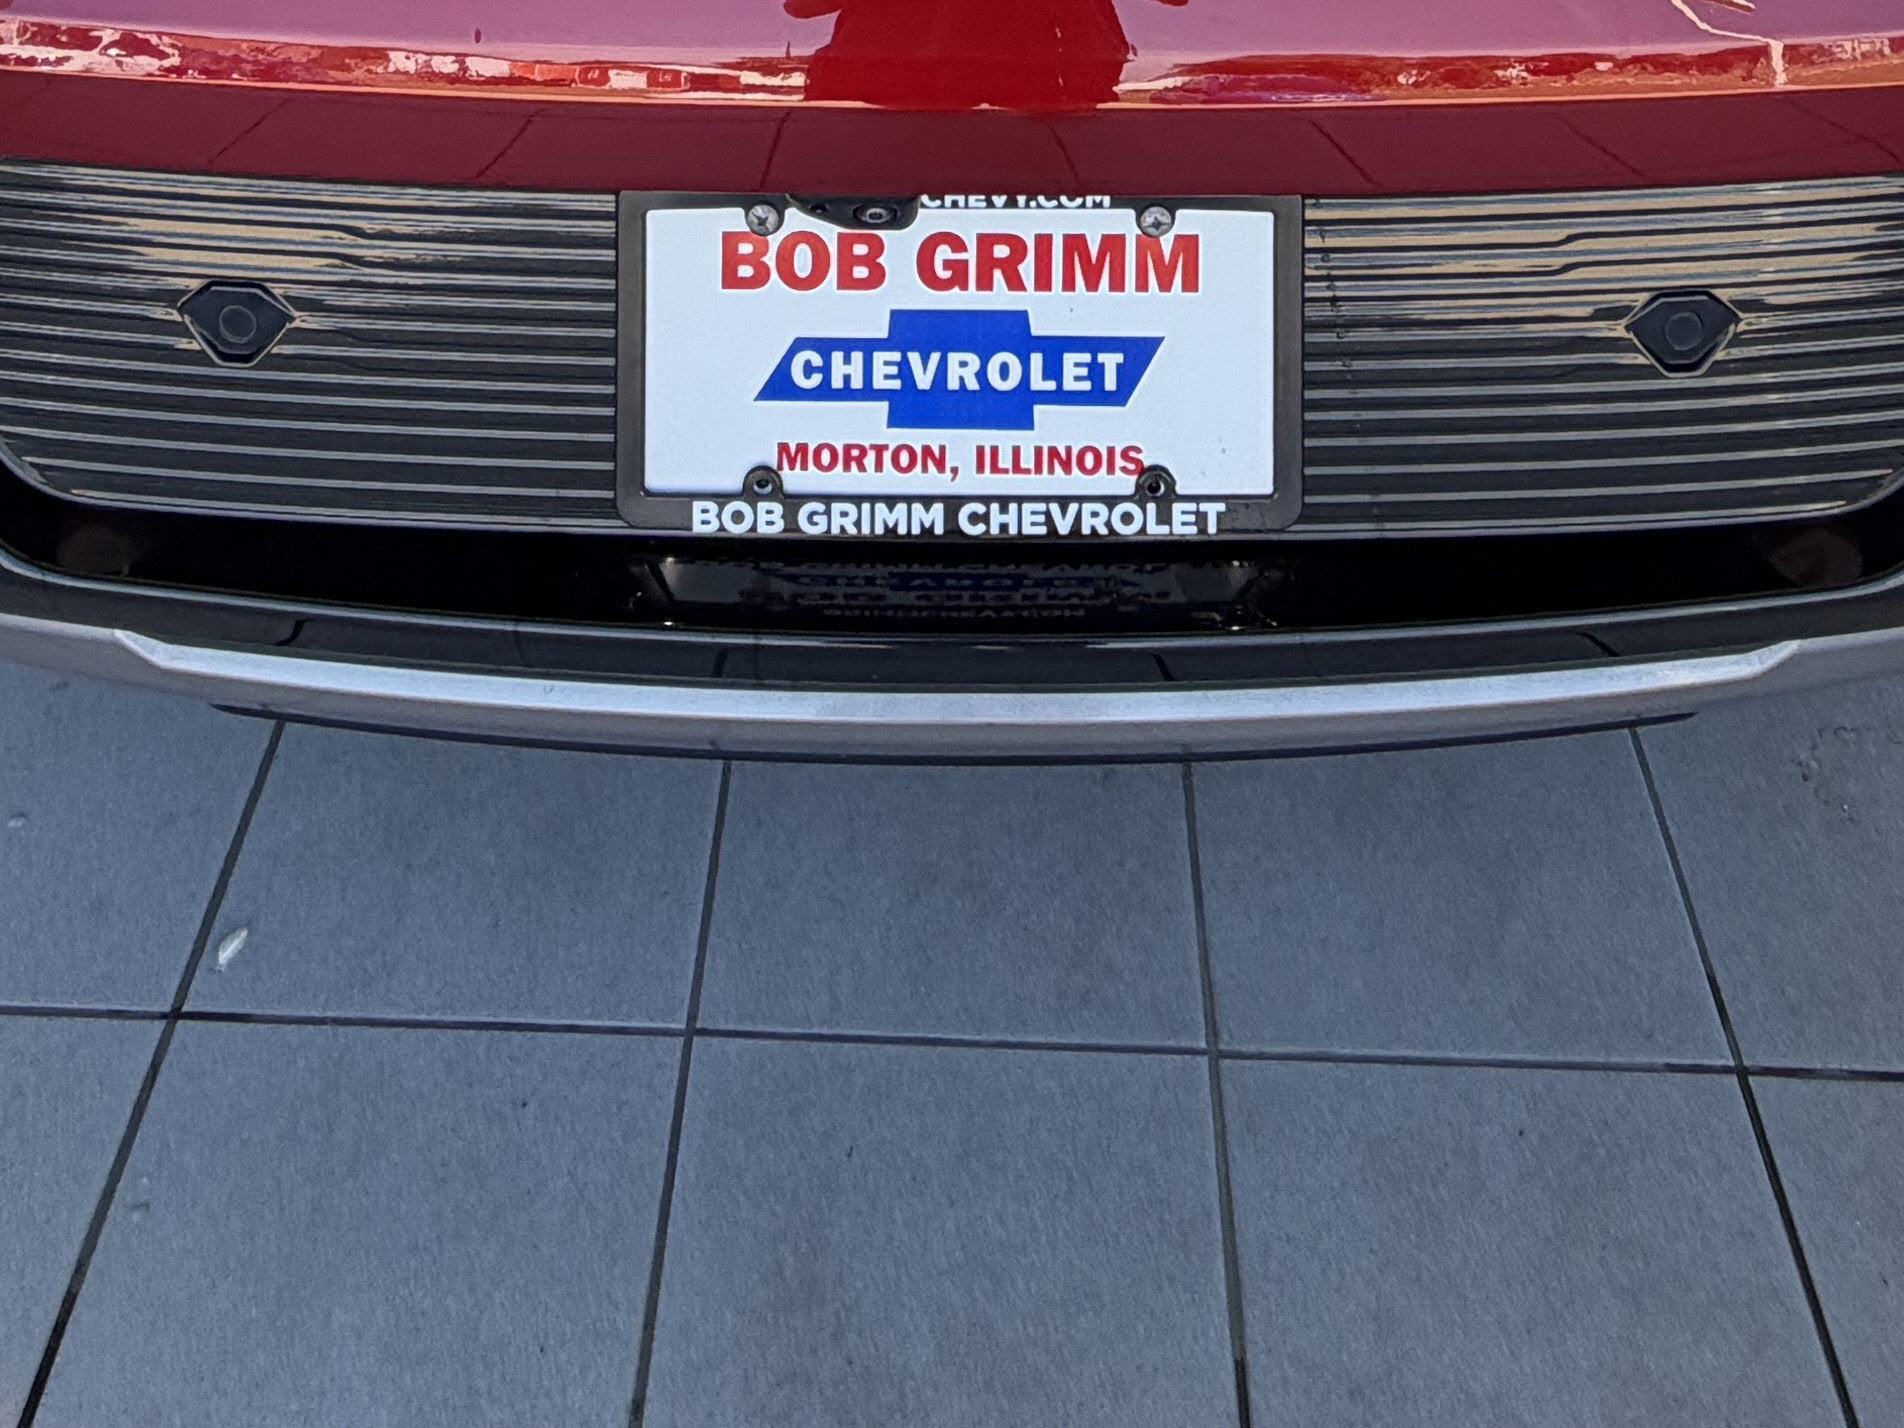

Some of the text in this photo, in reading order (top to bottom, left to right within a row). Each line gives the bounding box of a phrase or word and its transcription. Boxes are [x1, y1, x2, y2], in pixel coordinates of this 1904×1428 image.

[721, 230, 1200, 293] BOB GRIMM
[789, 350, 1126, 392] CHEVROLET
[776, 442, 1145, 481] MORTON, ILLINOIS
[692, 500, 1226, 536] BOB GRIMM CHEVROLET
